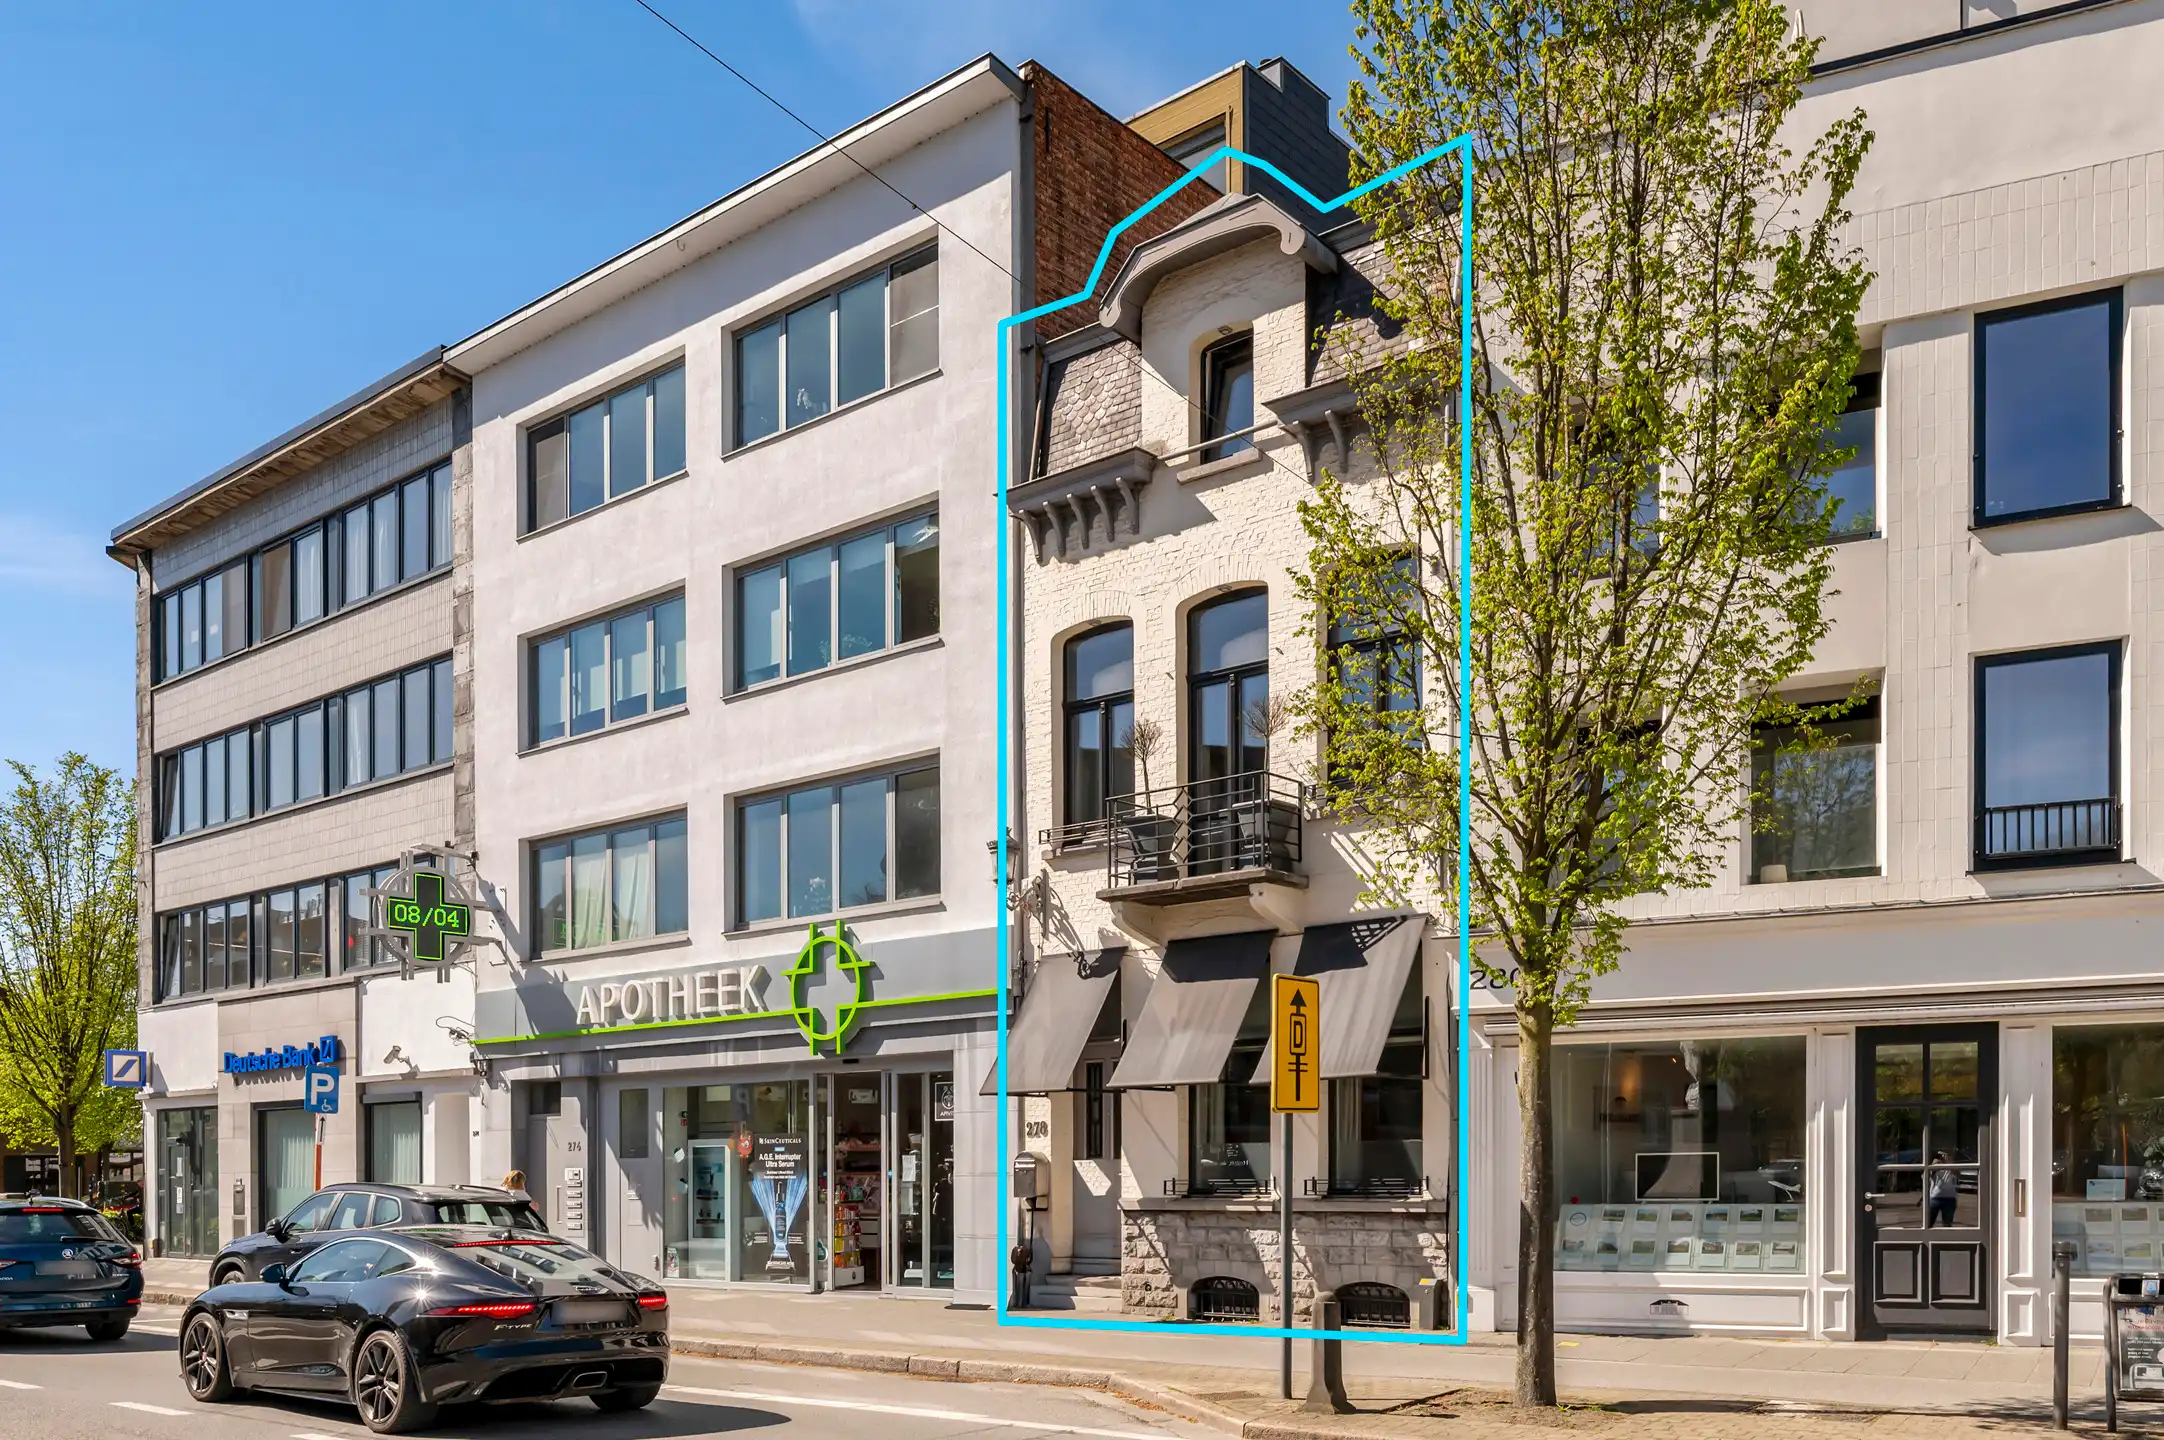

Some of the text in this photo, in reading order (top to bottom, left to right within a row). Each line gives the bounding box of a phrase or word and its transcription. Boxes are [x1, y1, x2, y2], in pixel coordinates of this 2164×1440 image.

[394, 903, 460, 928] 08/04
[577, 965, 769, 1025] APOTHEEK
[224, 1042, 316, 1073] Deutsche Bank
[310, 1072, 335, 1105] P
[1026, 1121, 1048, 1138] 278
[567, 1141, 581, 1152] 276
